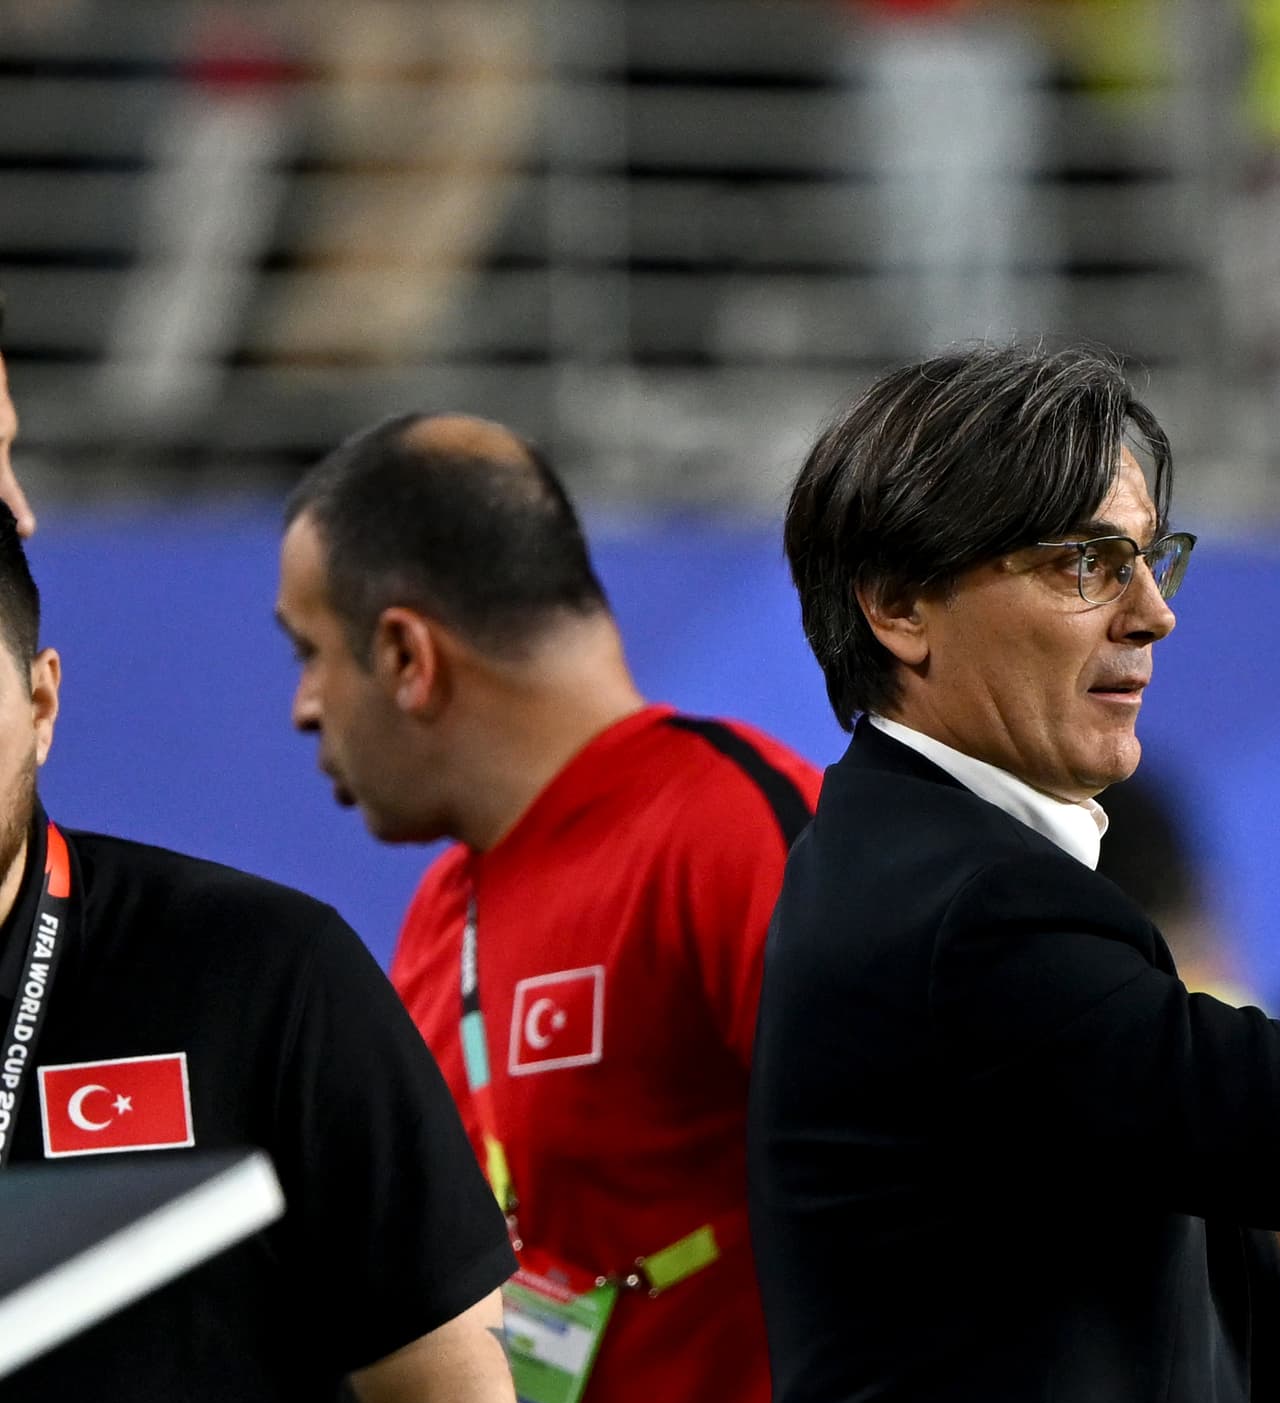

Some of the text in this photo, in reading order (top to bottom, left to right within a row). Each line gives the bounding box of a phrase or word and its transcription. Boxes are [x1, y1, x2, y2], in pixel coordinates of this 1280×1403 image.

[0, 912, 59, 1166] FIFA WORLD CUP 20
